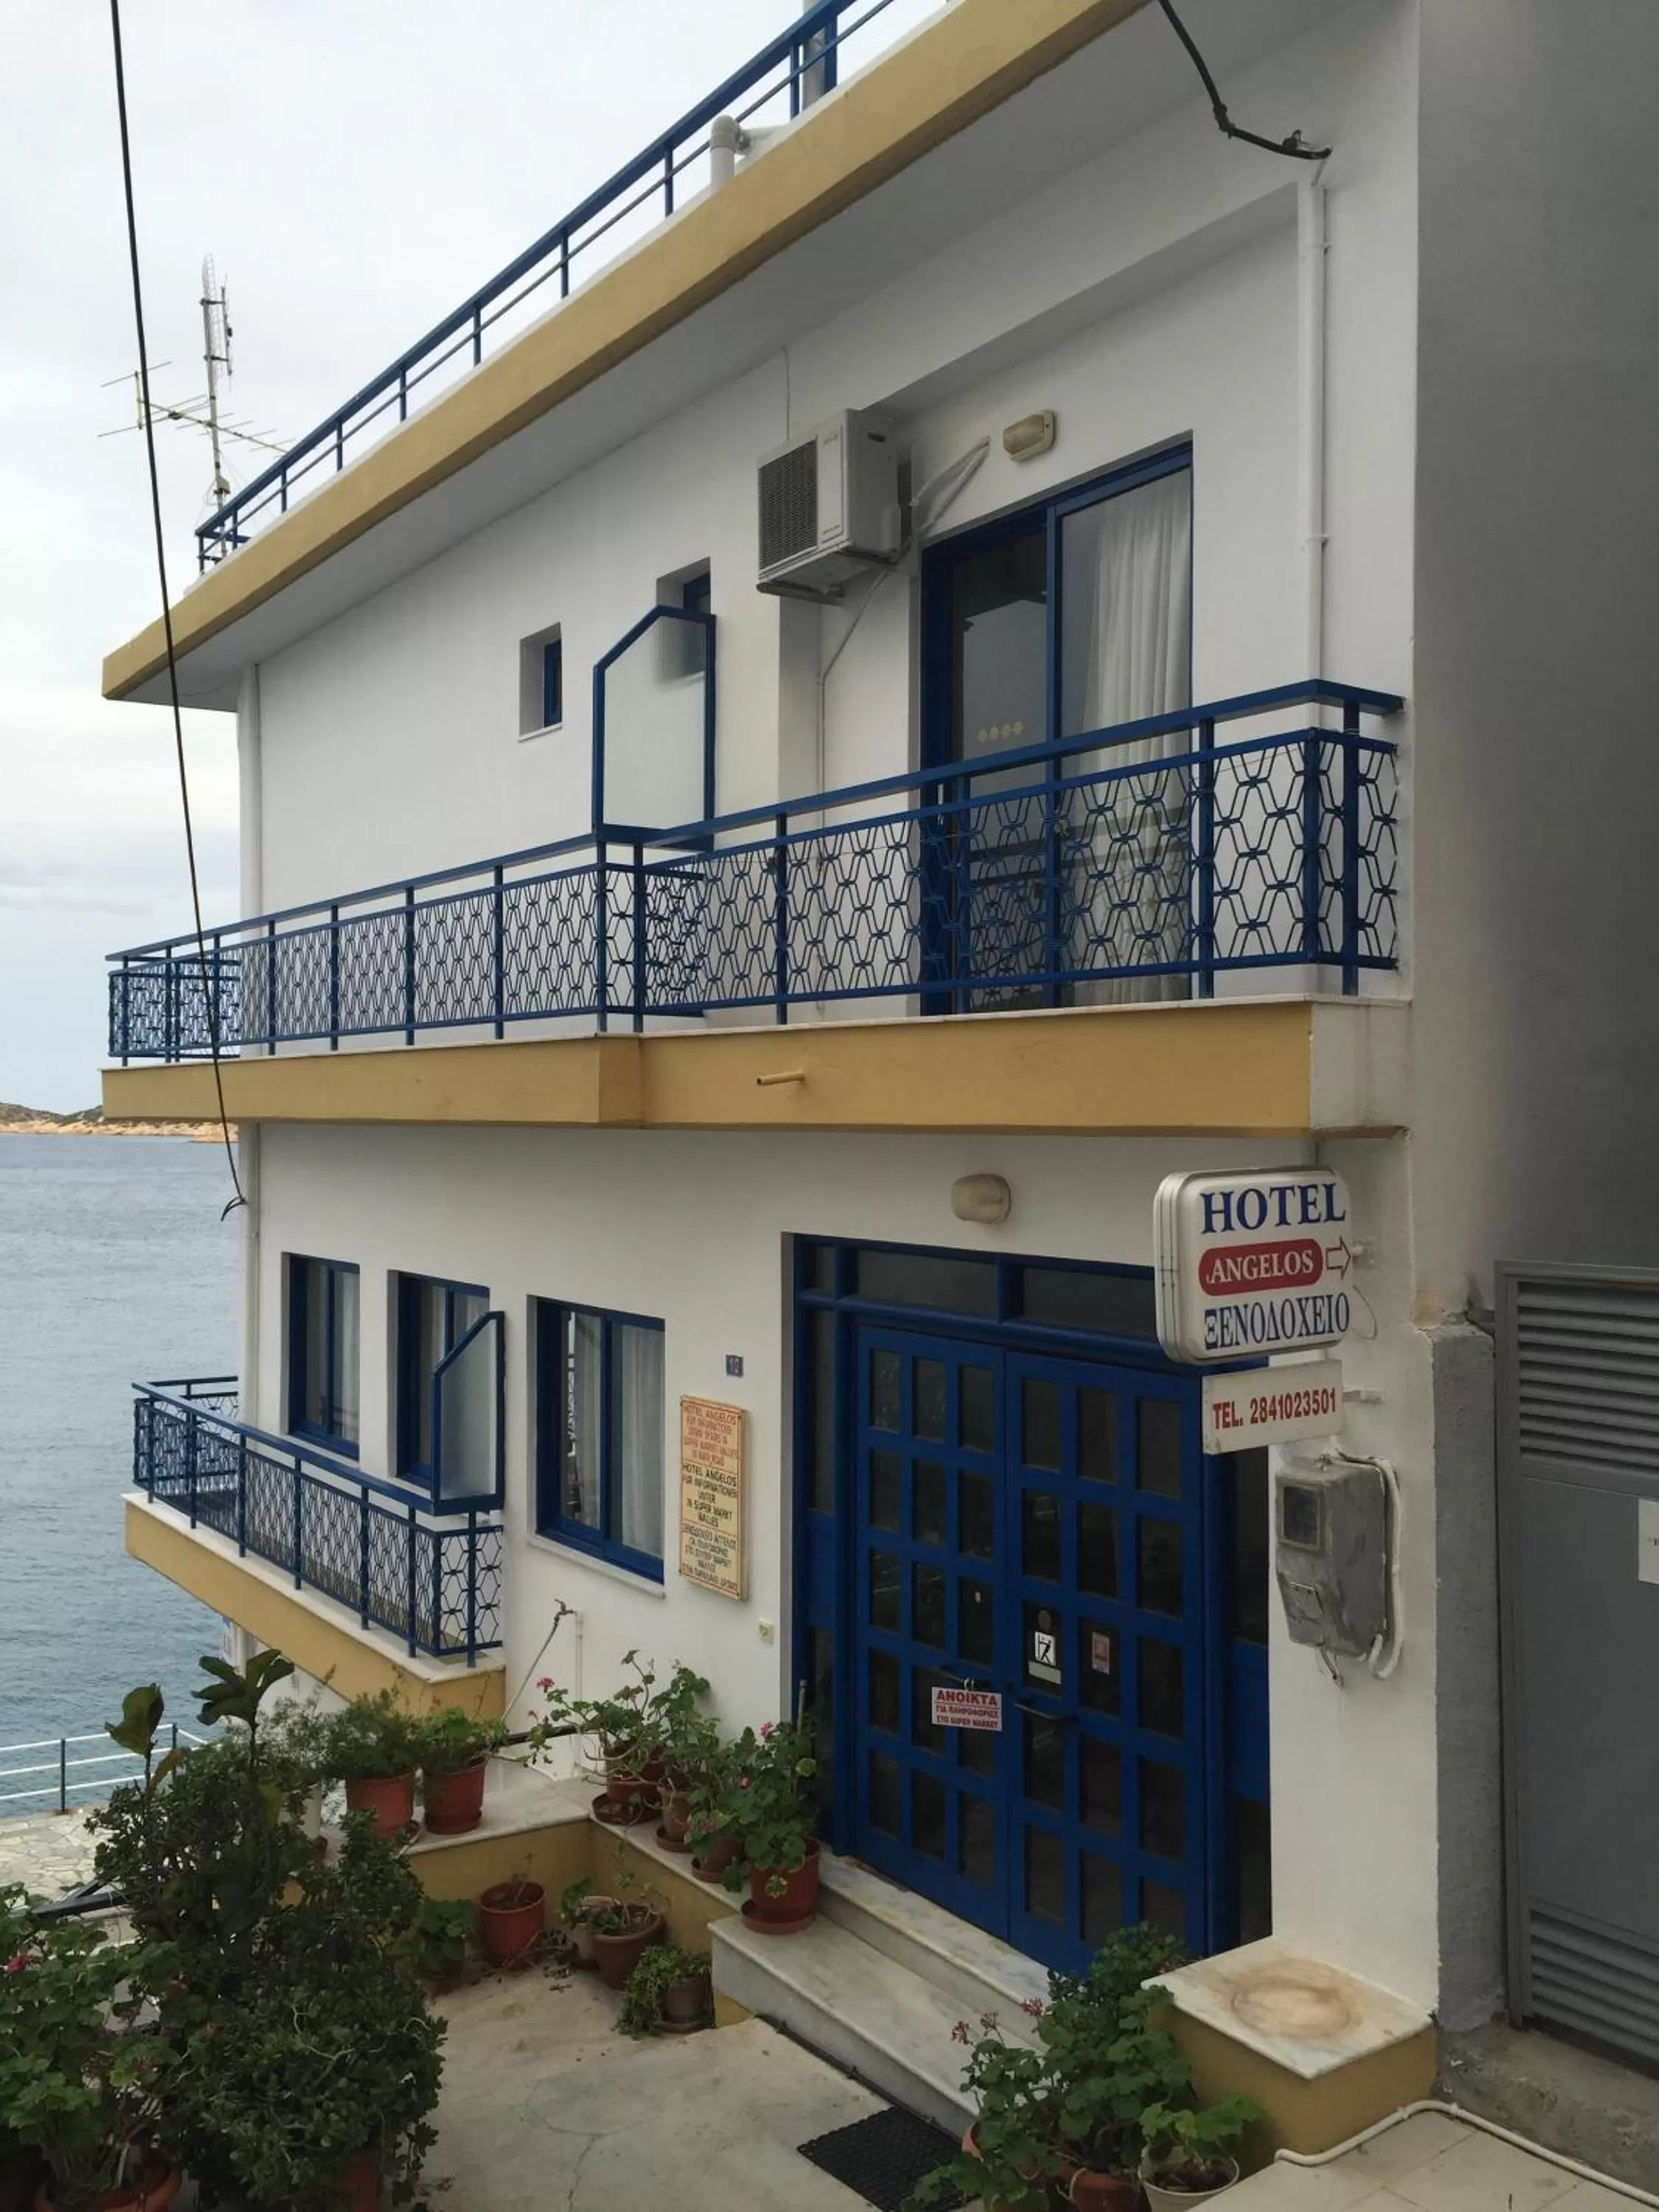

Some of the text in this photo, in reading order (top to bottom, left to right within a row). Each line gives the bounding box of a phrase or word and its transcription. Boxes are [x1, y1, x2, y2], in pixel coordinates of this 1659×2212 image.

[1200, 1183, 1346, 1234] HOTEL
[1206, 1249, 1314, 1284] ANGELOS
[1204, 1292, 1350, 1350] ΞΕΝΟΔΟΧΕΙΟ
[1212, 1386, 1337, 1429] TEL. 2841023501
[681, 1462, 737, 1487] HOTEL ANGELOS
[936, 1689, 998, 1706] ΑΝΟΙΚΤΑ
